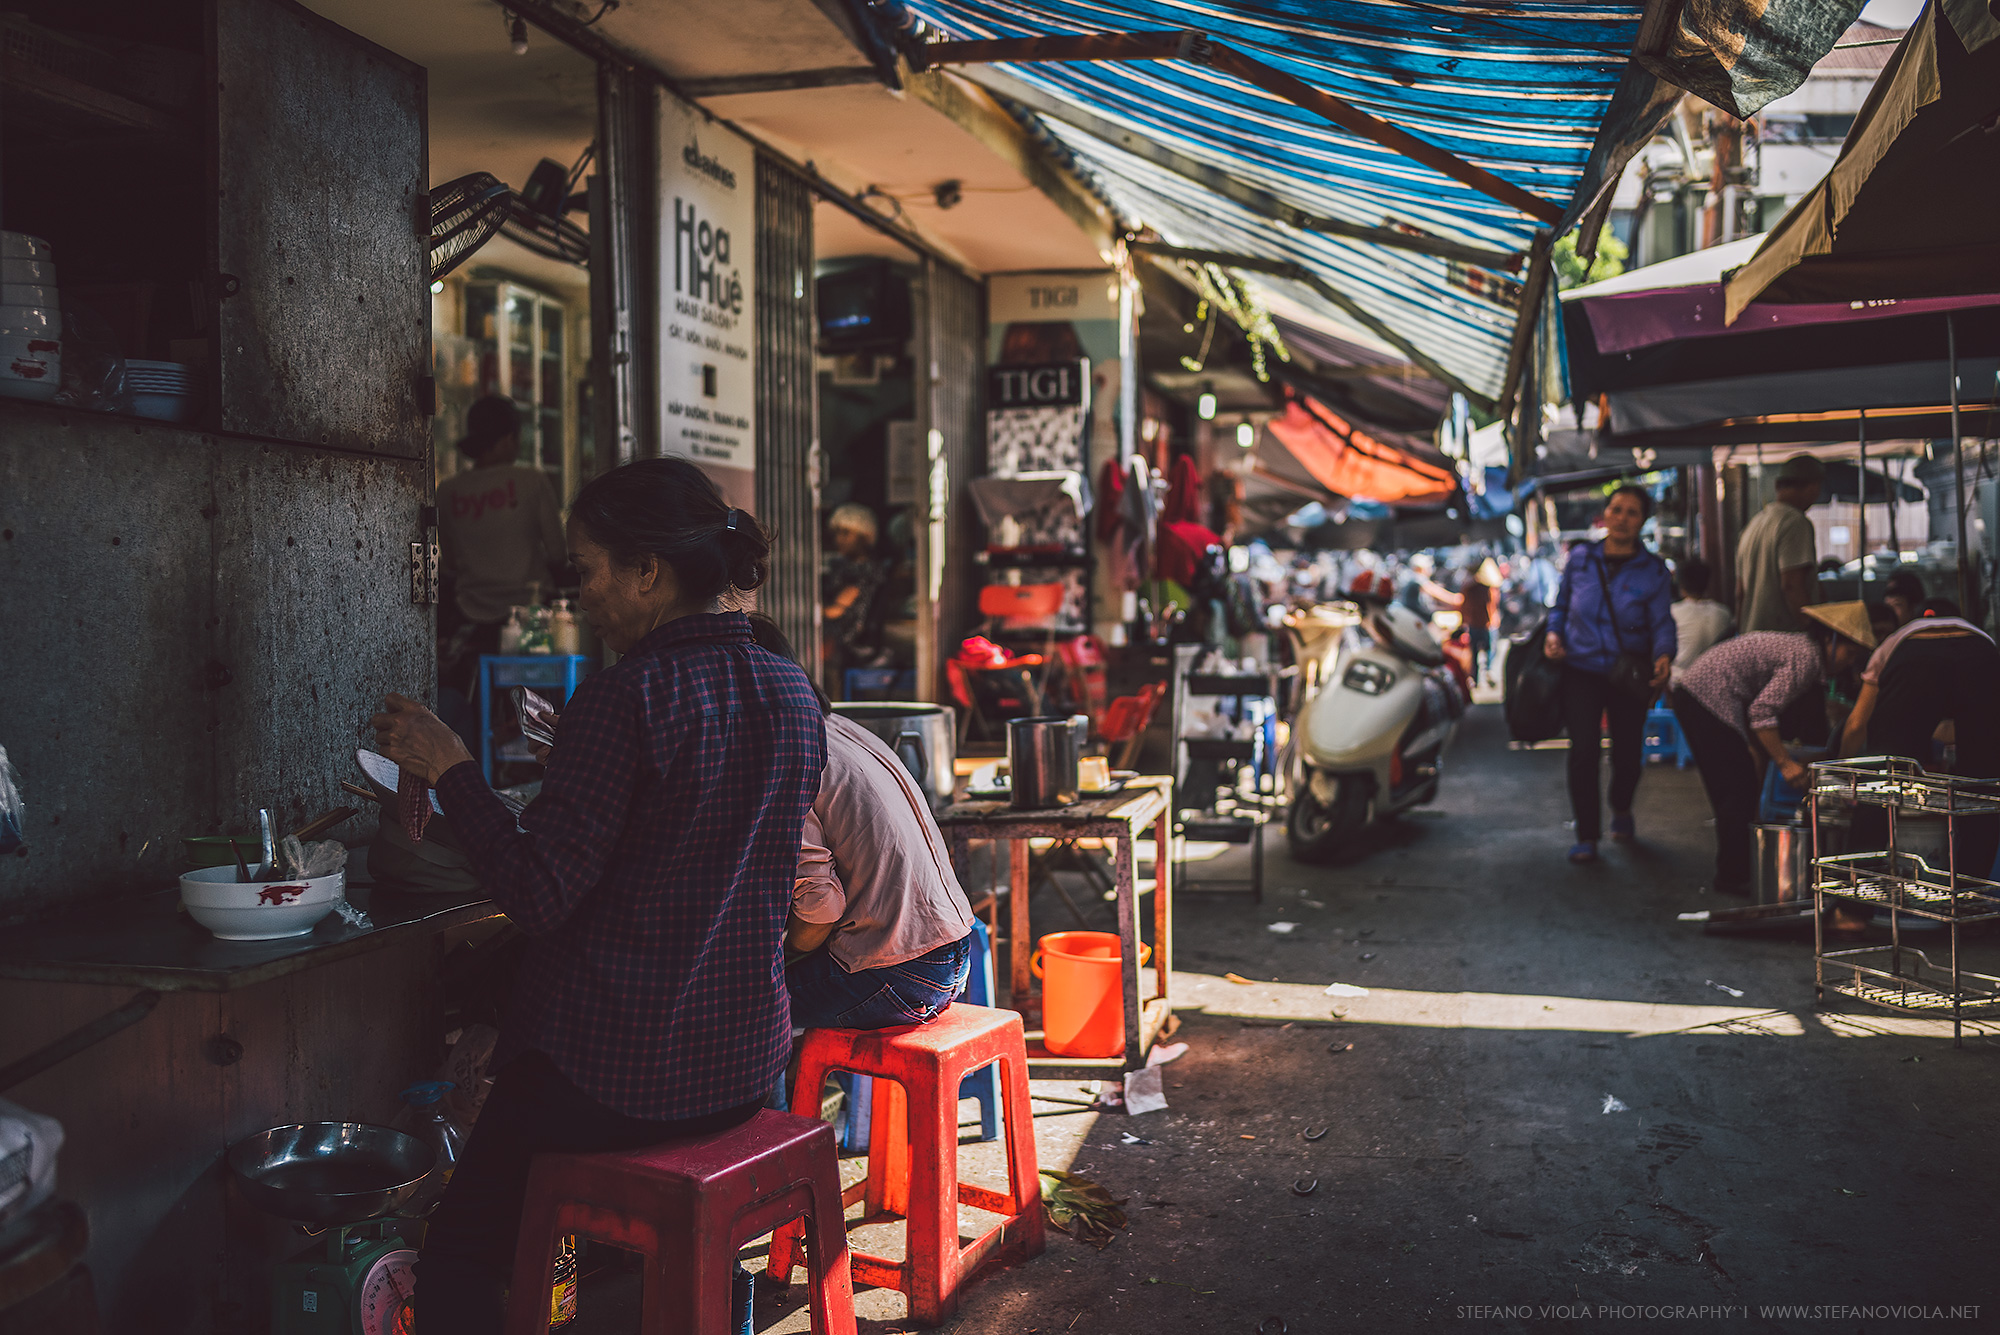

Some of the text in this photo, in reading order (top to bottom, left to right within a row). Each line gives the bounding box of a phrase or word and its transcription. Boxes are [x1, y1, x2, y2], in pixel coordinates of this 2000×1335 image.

[675, 197, 731, 296] Hoa
[1028, 286, 1079, 308] TIGI
[997, 367, 1070, 401] TIGI
